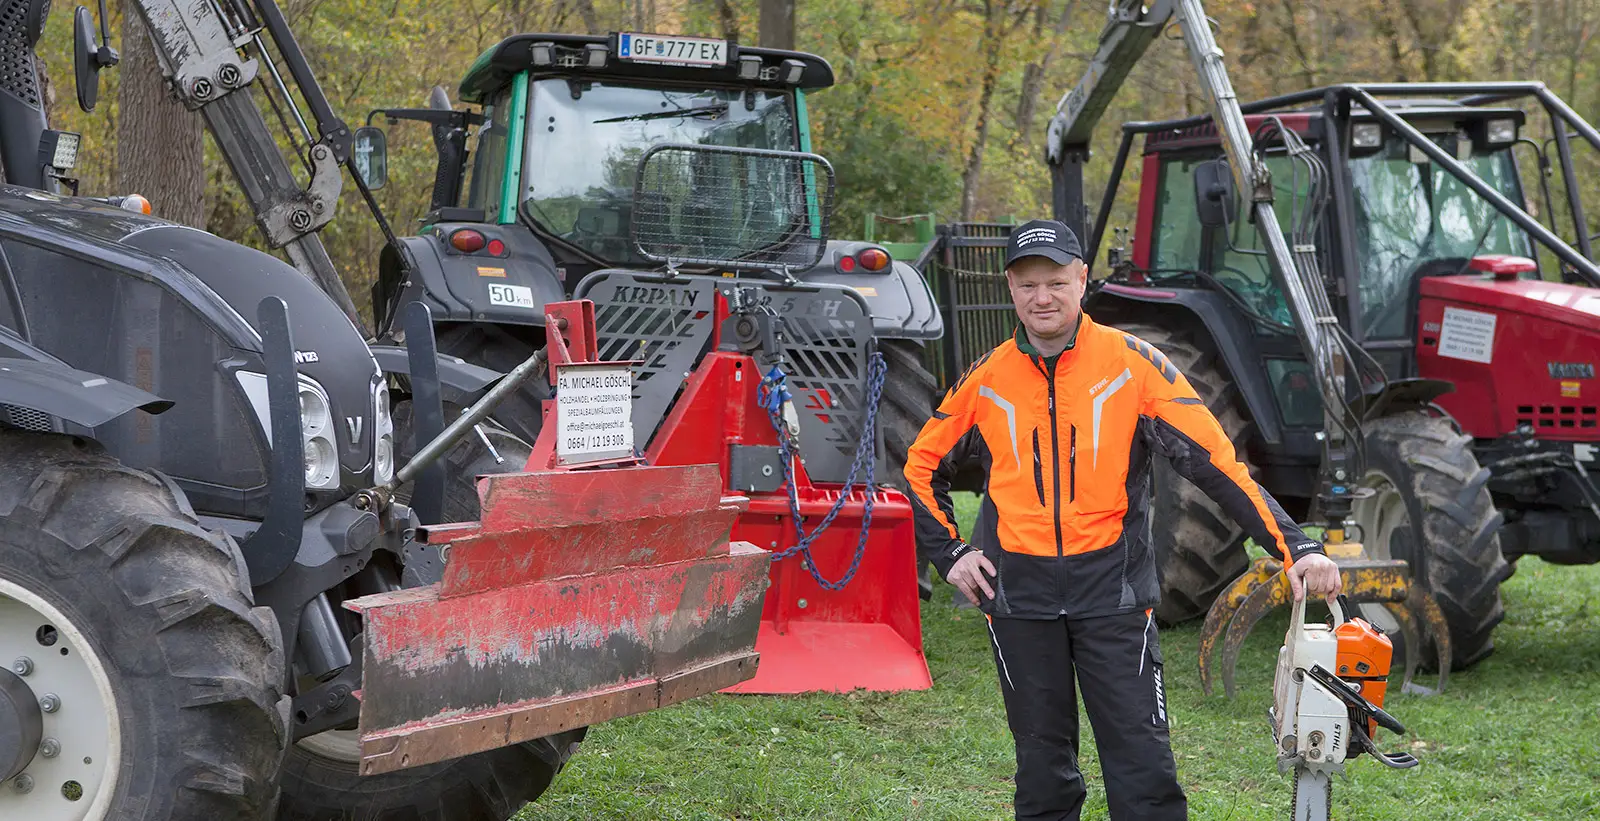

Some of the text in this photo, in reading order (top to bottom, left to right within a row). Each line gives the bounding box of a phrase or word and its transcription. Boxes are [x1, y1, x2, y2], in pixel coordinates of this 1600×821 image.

[634, 39, 720, 60] GF 777 EX
[491, 286, 532, 305] 50 km
[611, 286, 700, 307] KRPAN
[560, 374, 631, 389] FA. MICHAEL GÖSCHL
[1089, 376, 1109, 395] STIHL
[560, 393, 628, 405] HOLZHANDEL HOLZBRINGUNG
[567, 405, 624, 417] SPEZIALBAUMFÄLLUNGEN
[566, 420, 625, 433] office@michaelgoeschl.at
[567, 434, 625, 450] 0664 / 12 19 308
[1297, 542, 1318, 551] STIHL
[1154, 668, 1166, 722] STIHL
[1332, 723, 1342, 752] STIHL
